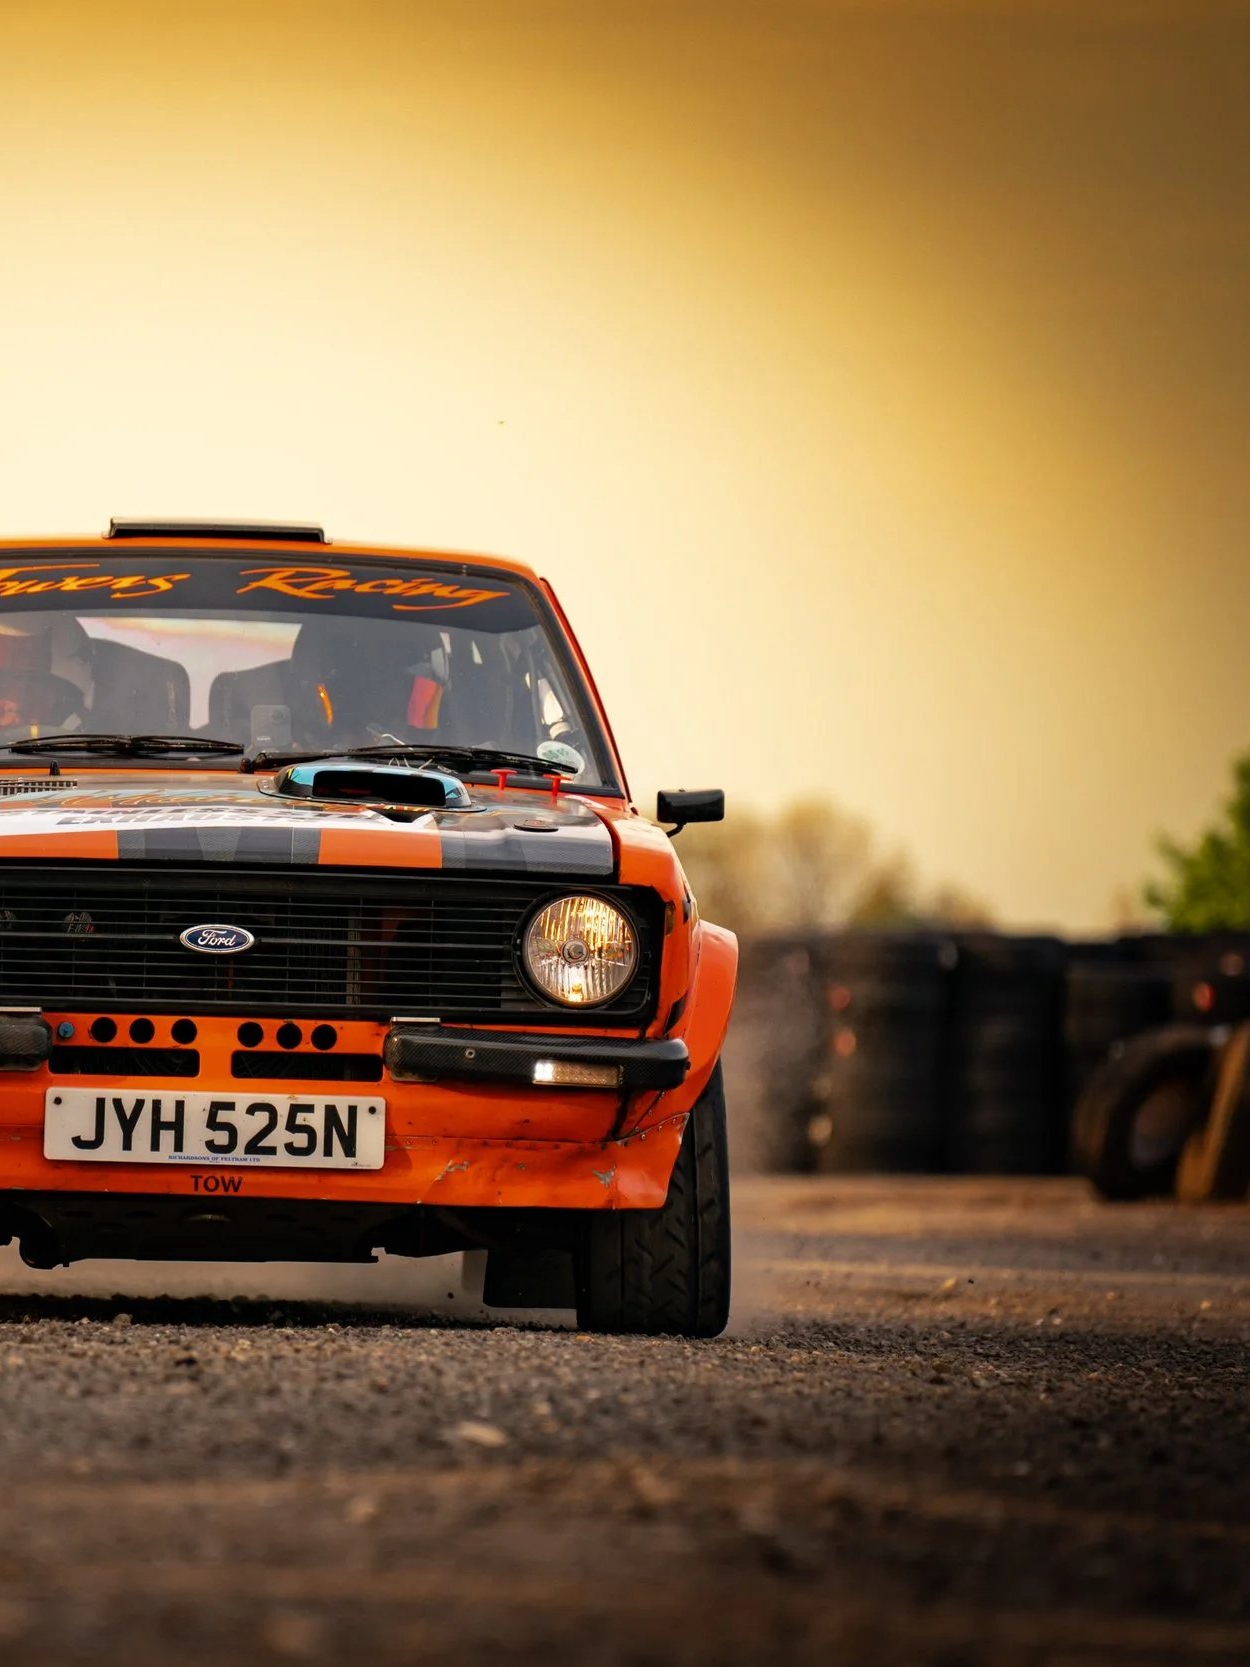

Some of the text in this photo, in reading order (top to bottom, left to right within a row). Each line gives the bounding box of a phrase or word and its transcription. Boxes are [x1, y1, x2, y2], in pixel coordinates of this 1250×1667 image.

[236, 566, 511, 611] Racing
[197, 929, 237, 946] Ford
[71, 1097, 358, 1158] JYH 525N
[190, 1174, 244, 1193] TOW
